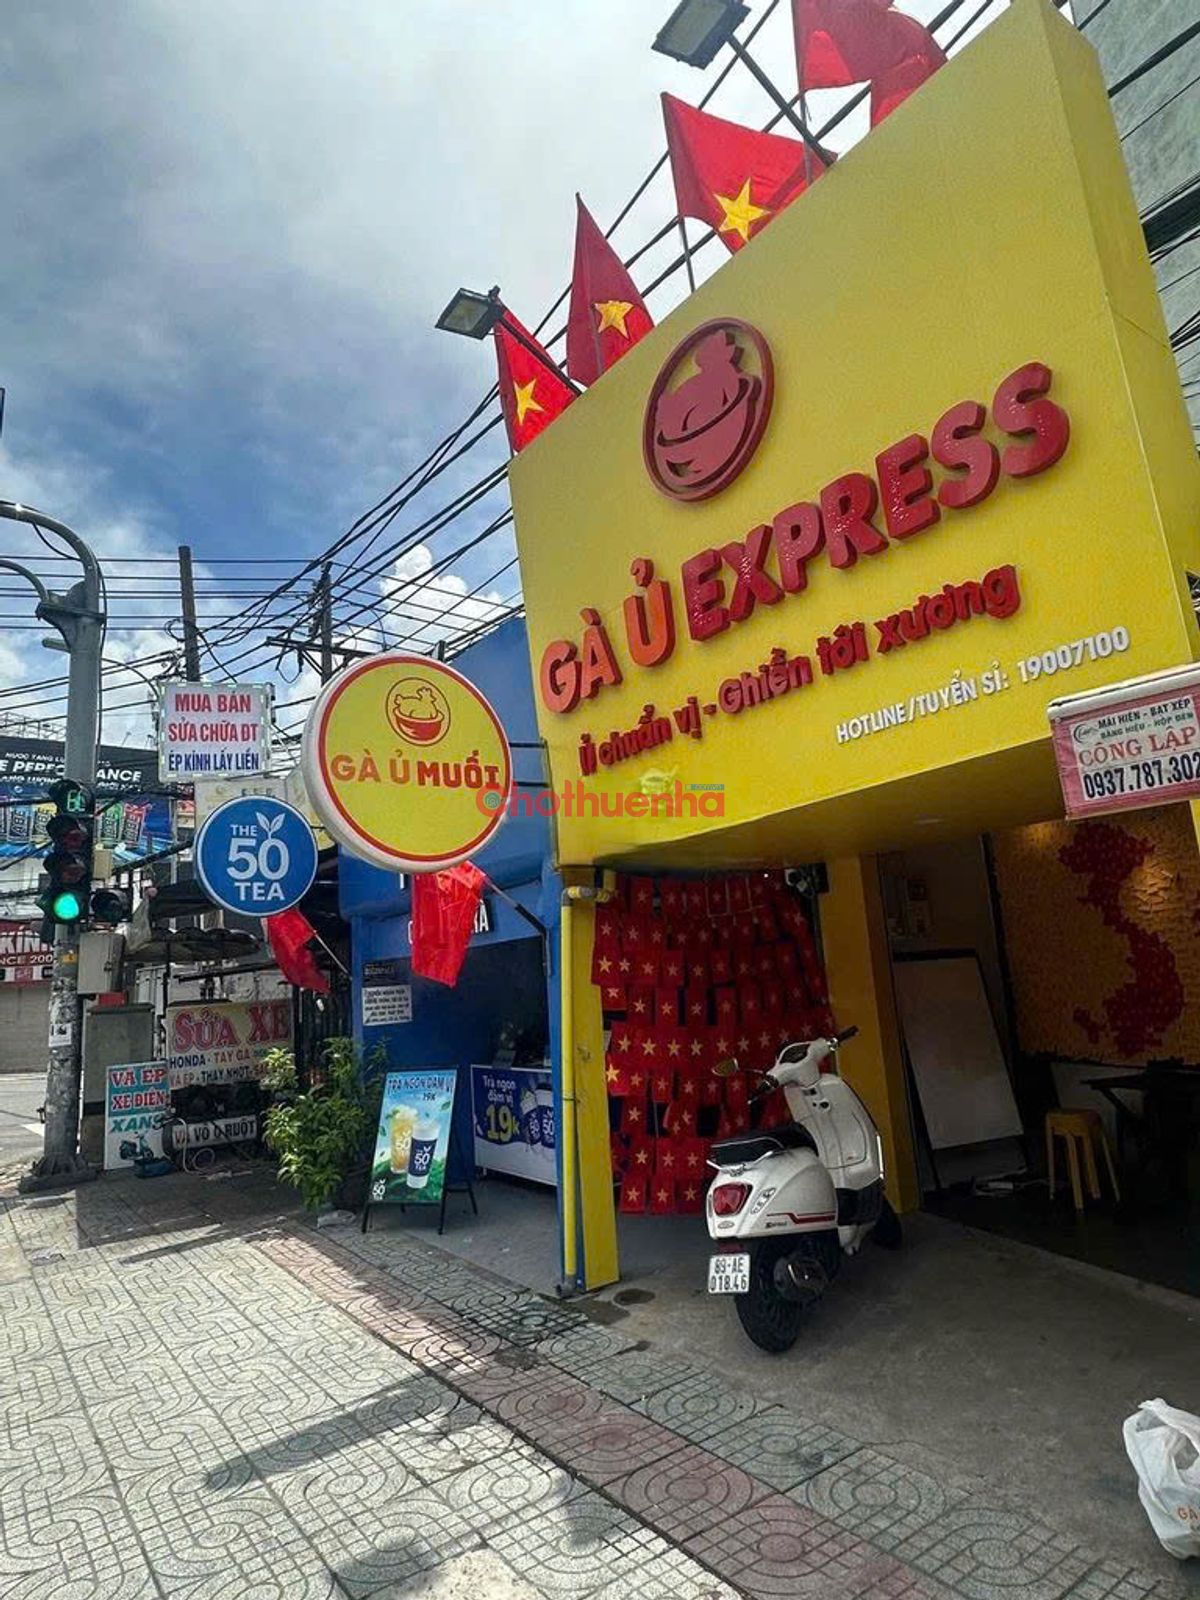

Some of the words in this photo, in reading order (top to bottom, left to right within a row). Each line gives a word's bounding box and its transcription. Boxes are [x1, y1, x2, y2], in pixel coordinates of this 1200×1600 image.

[540, 608, 622, 714] GÀ
[623, 557, 676, 666] Ủ
[682, 361, 1070, 641] EXPRESS
[599, 704, 673, 765] chuẩn
[674, 696, 702, 739] vị
[874, 564, 1021, 654] xương
[836, 668, 978, 743] HOTLINE/TUYỂN
[1018, 626, 1131, 684] 19007100
[175, 694, 212, 712] MUA
[217, 690, 251, 712] BÁN
[168, 716, 197, 742] SỬA
[200, 721, 238, 742] CHỮA
[241, 723, 259, 741] ĐT
[1079, 742, 1142, 767] CÔNG
[1148, 725, 1197, 752] LẬP
[168, 750, 182, 771] ÉP
[184, 750, 211, 771] KÍNH
[213, 747, 233, 771] LẤY
[331, 748, 381, 782] GÀ
[389, 749, 411, 784] Ủ
[416, 749, 500, 789] MUỐI
[1083, 751, 1200, 798] 0937.787.302
[230, 824, 258, 837] THE
[226, 837, 290, 880] 50
[234, 882, 286, 901] TEA
[174, 1006, 237, 1053] SỬA
[249, 1002, 289, 1042] XE
[170, 1054, 206, 1069] HONDA
[112, 1094, 131, 1110] XE
